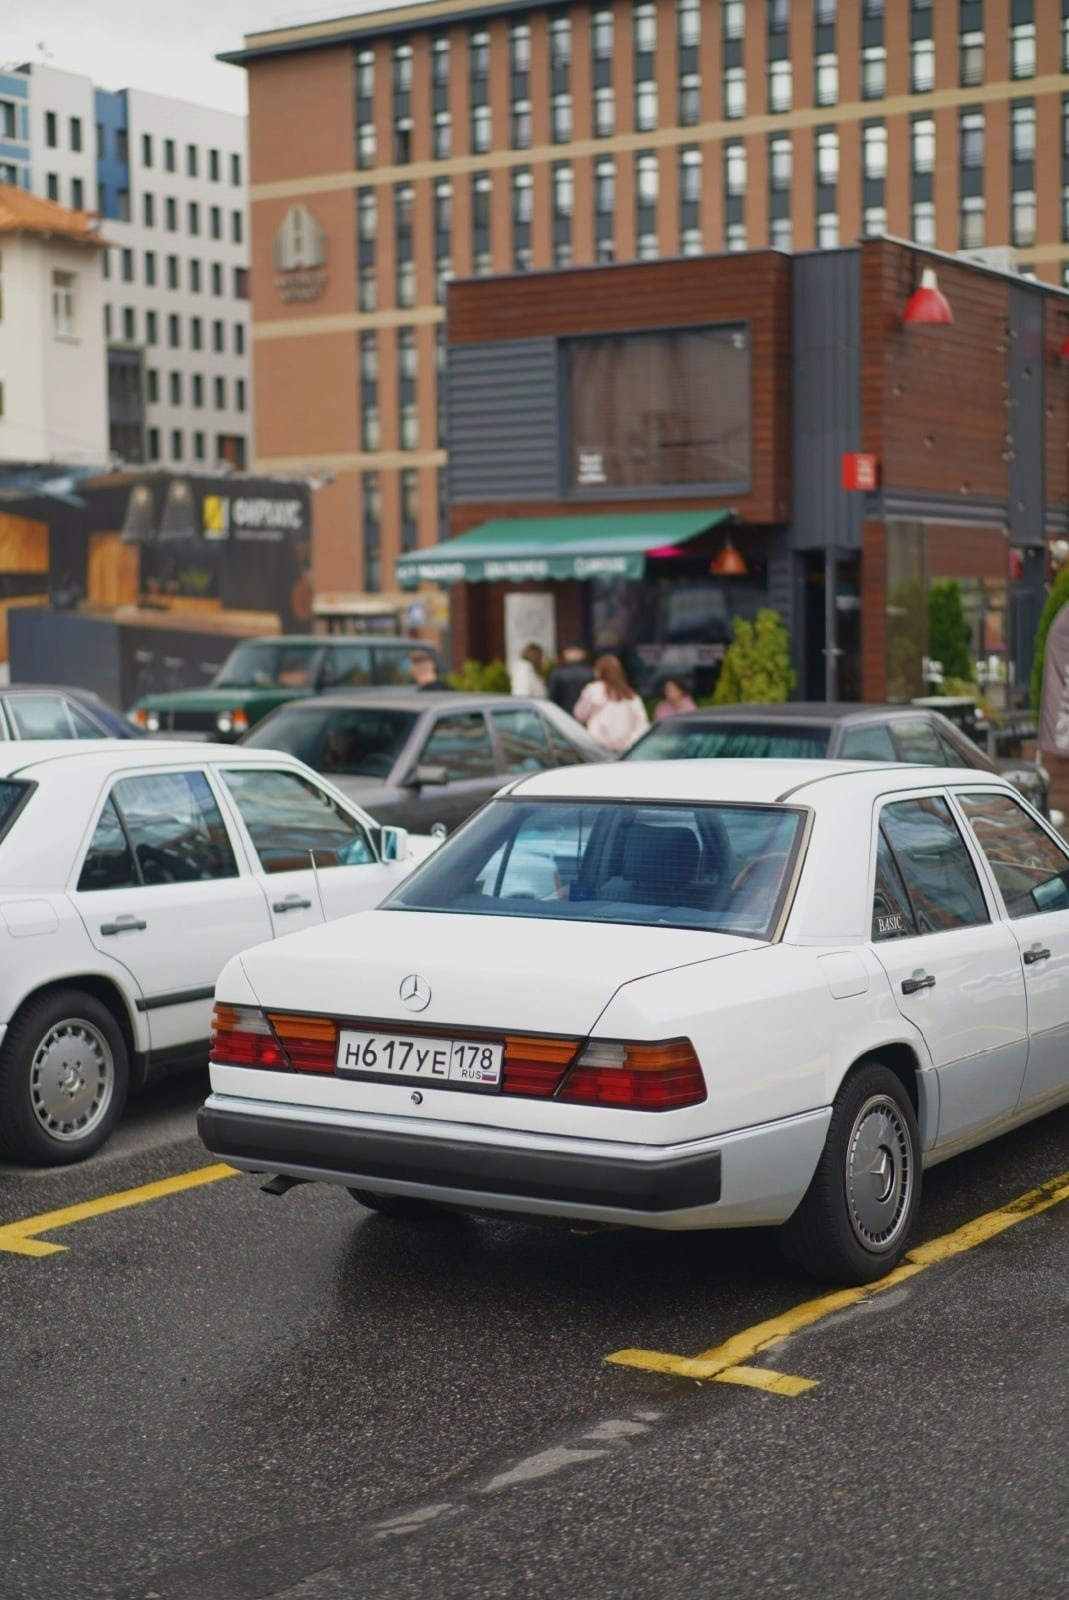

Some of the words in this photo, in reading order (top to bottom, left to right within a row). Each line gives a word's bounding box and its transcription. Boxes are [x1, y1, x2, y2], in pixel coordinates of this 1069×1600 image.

[878, 915, 902, 932] BASIC
[454, 1045, 493, 1070] 178
[461, 1069, 482, 1080] RUS
